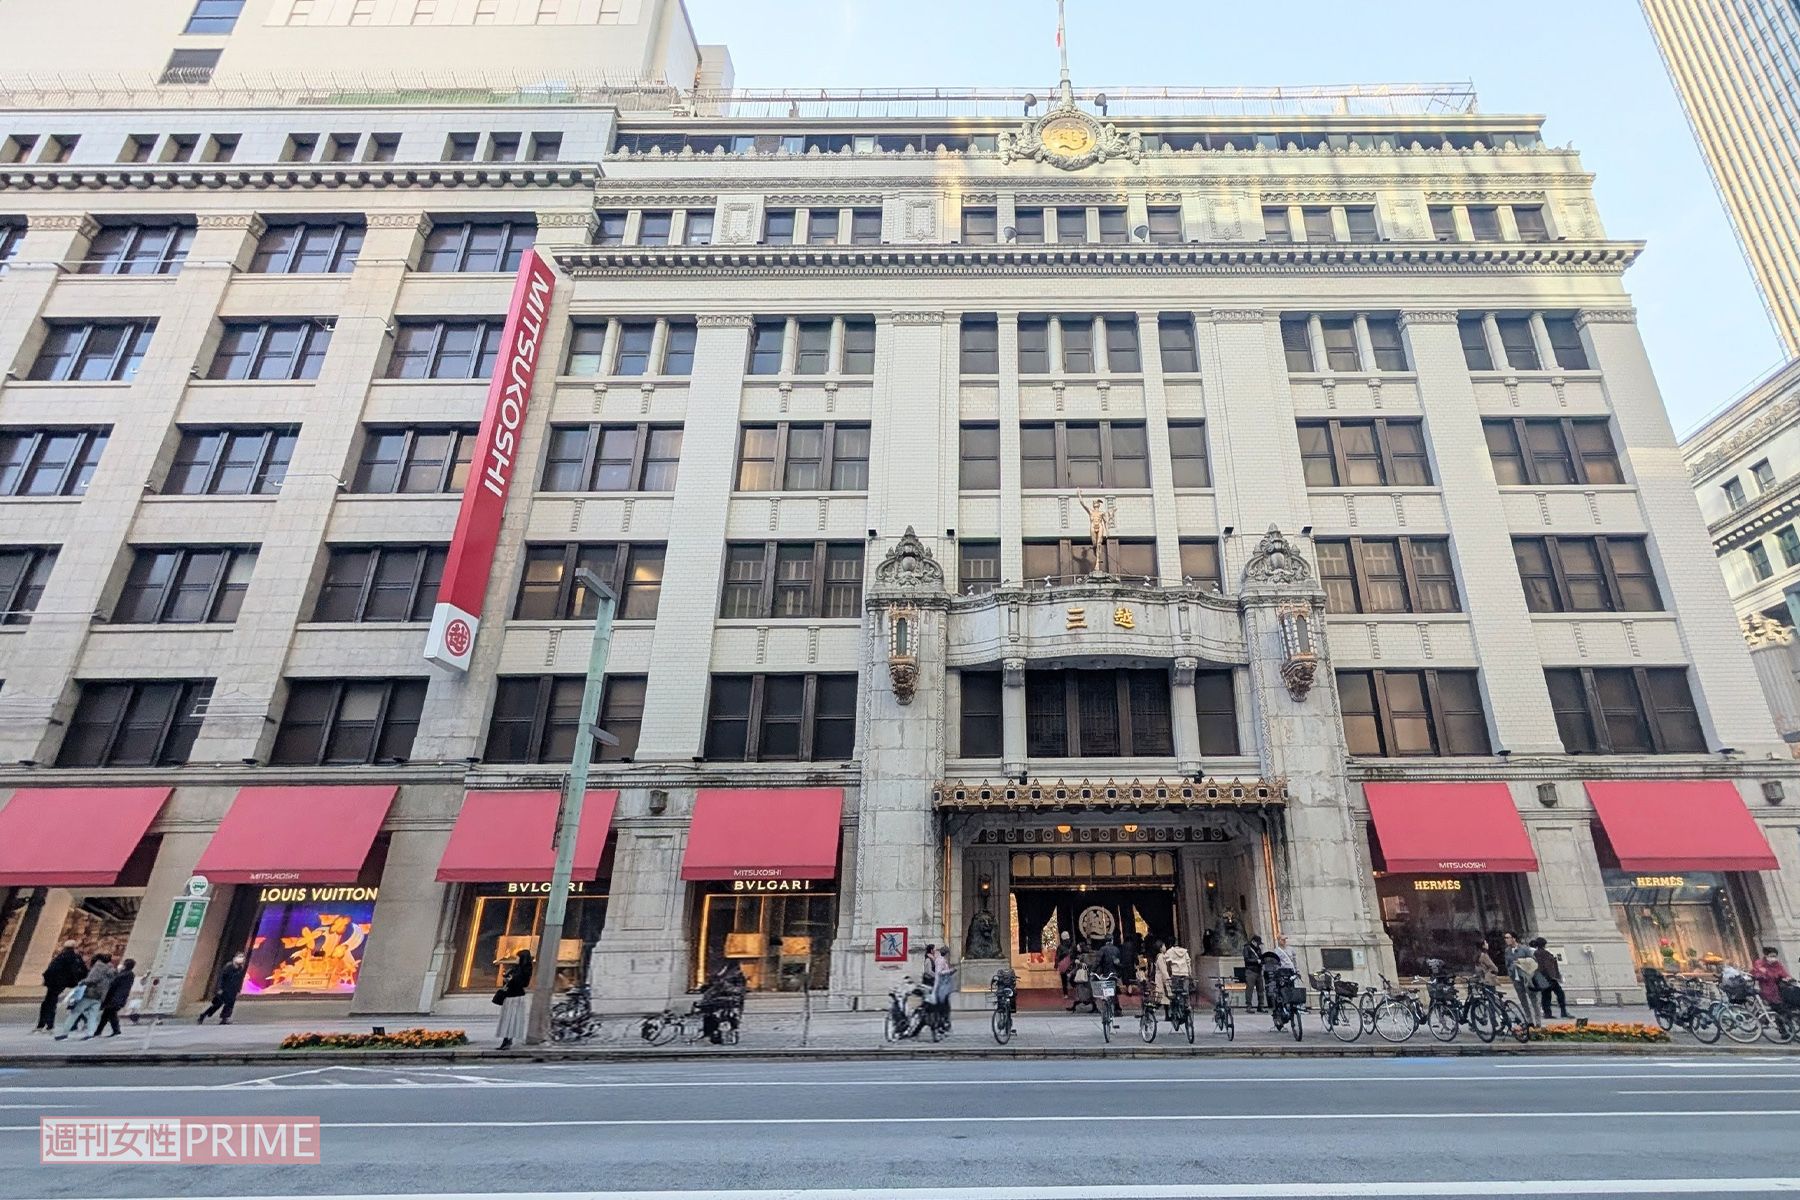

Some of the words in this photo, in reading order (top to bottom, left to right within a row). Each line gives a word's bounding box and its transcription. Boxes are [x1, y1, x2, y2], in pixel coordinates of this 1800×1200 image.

[484, 271, 549, 497] MITSUKOSHI
[1066, 607, 1136, 630] 三越
[249, 872, 299, 880] MITSUKOSHI
[508, 882, 584, 893] BVLGRI
[734, 880, 810, 890] BVLGARI
[260, 888, 306, 901] LOUIS
[311, 887, 378, 901] VUITTON
